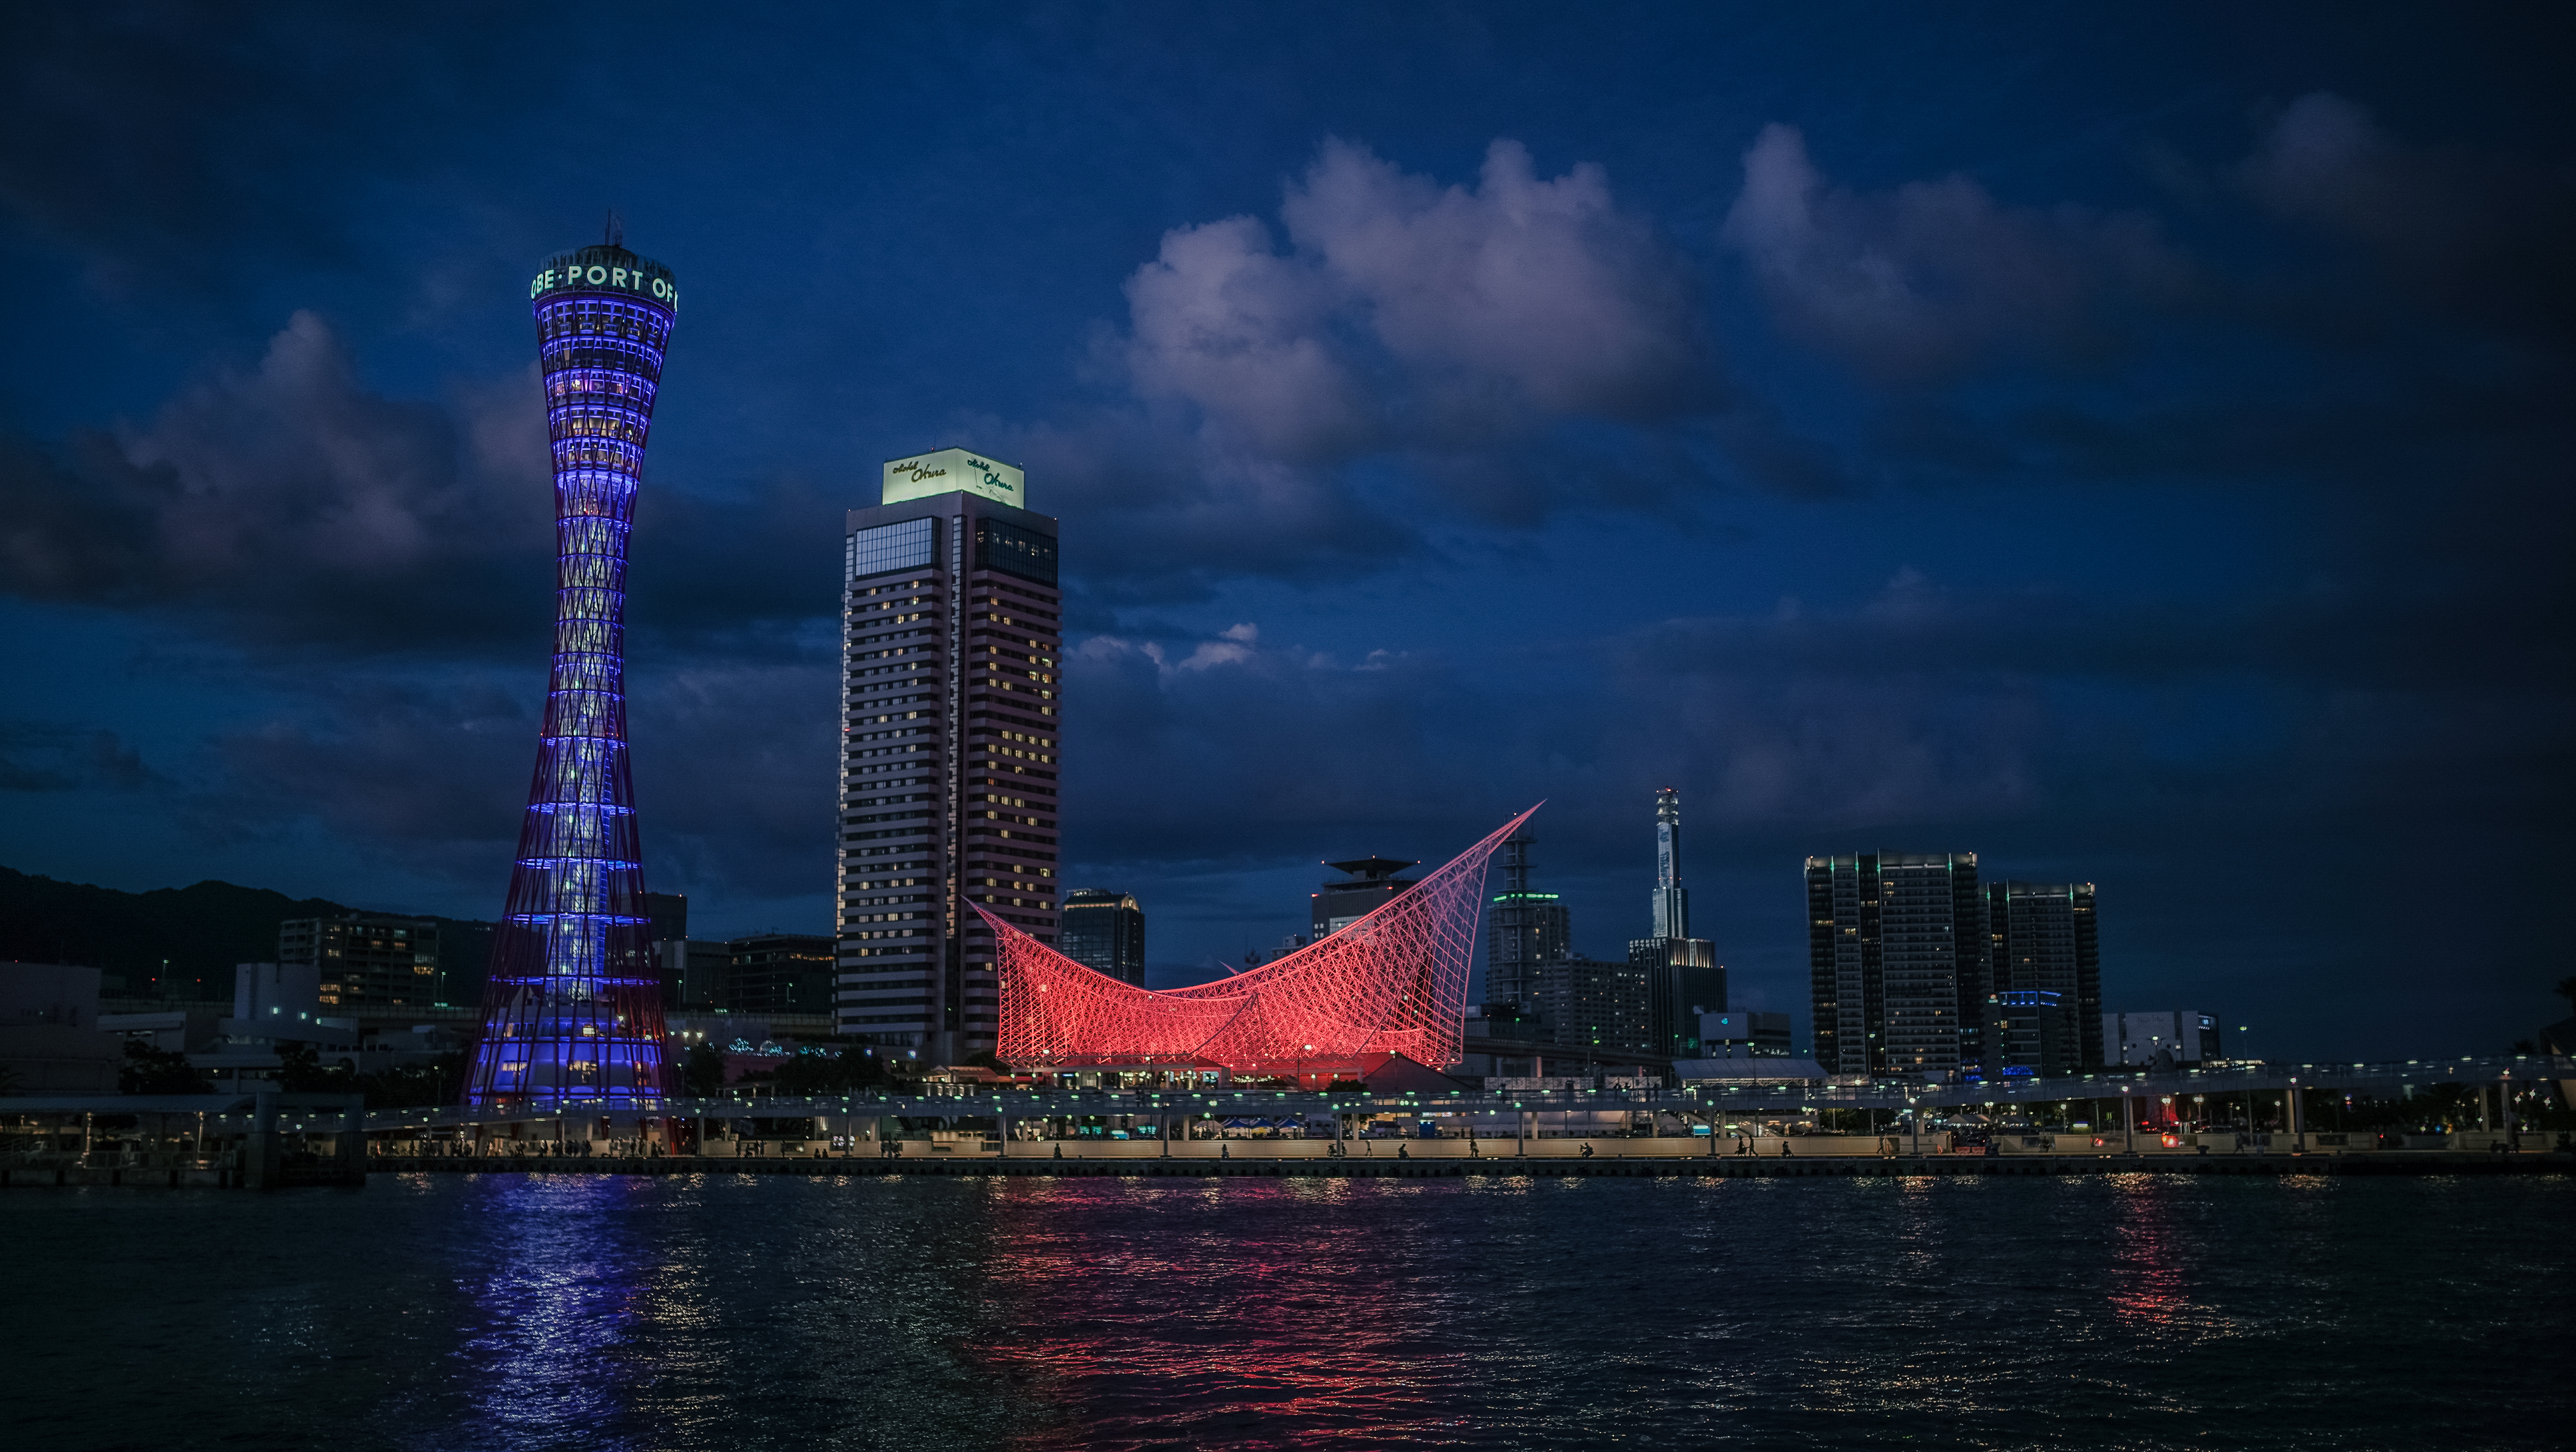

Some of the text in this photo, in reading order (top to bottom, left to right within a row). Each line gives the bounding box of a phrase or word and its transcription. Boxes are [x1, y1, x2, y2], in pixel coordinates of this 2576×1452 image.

[567, 265, 643, 290] PORT
[652, 278, 673, 302] OF
[911, 463, 947, 483] Okura
[984, 473, 1014, 491] Okura
